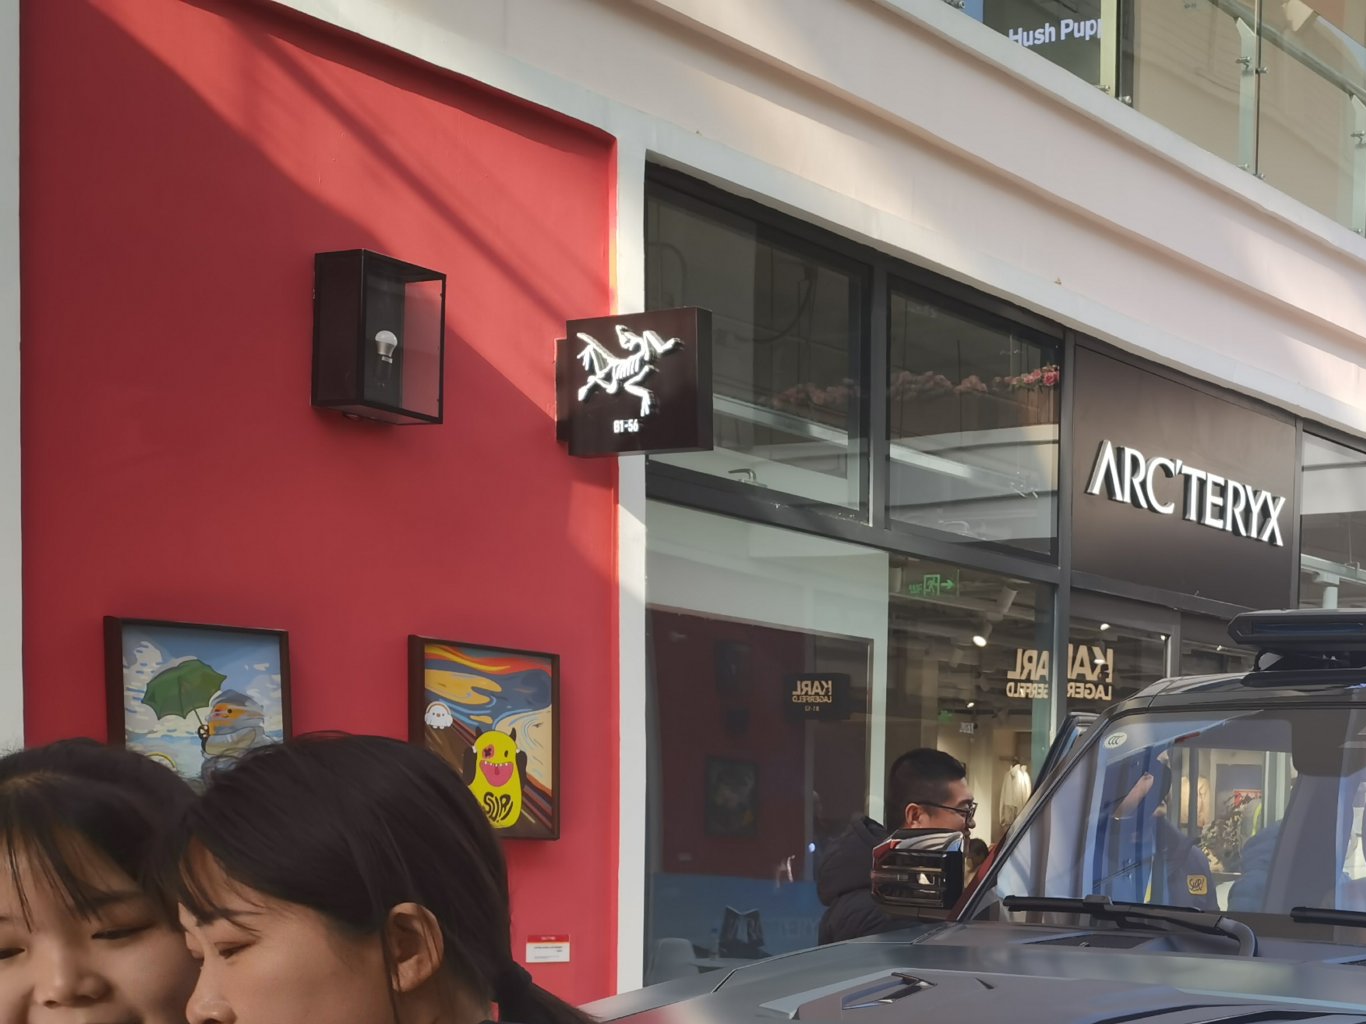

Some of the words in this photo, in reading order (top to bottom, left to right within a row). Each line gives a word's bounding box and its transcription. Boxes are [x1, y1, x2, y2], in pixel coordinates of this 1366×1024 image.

[1008, 23, 1056, 48] Hush
[613, 419, 639, 434] B1-56
[1085, 439, 1287, 547] ARC'TERYX
